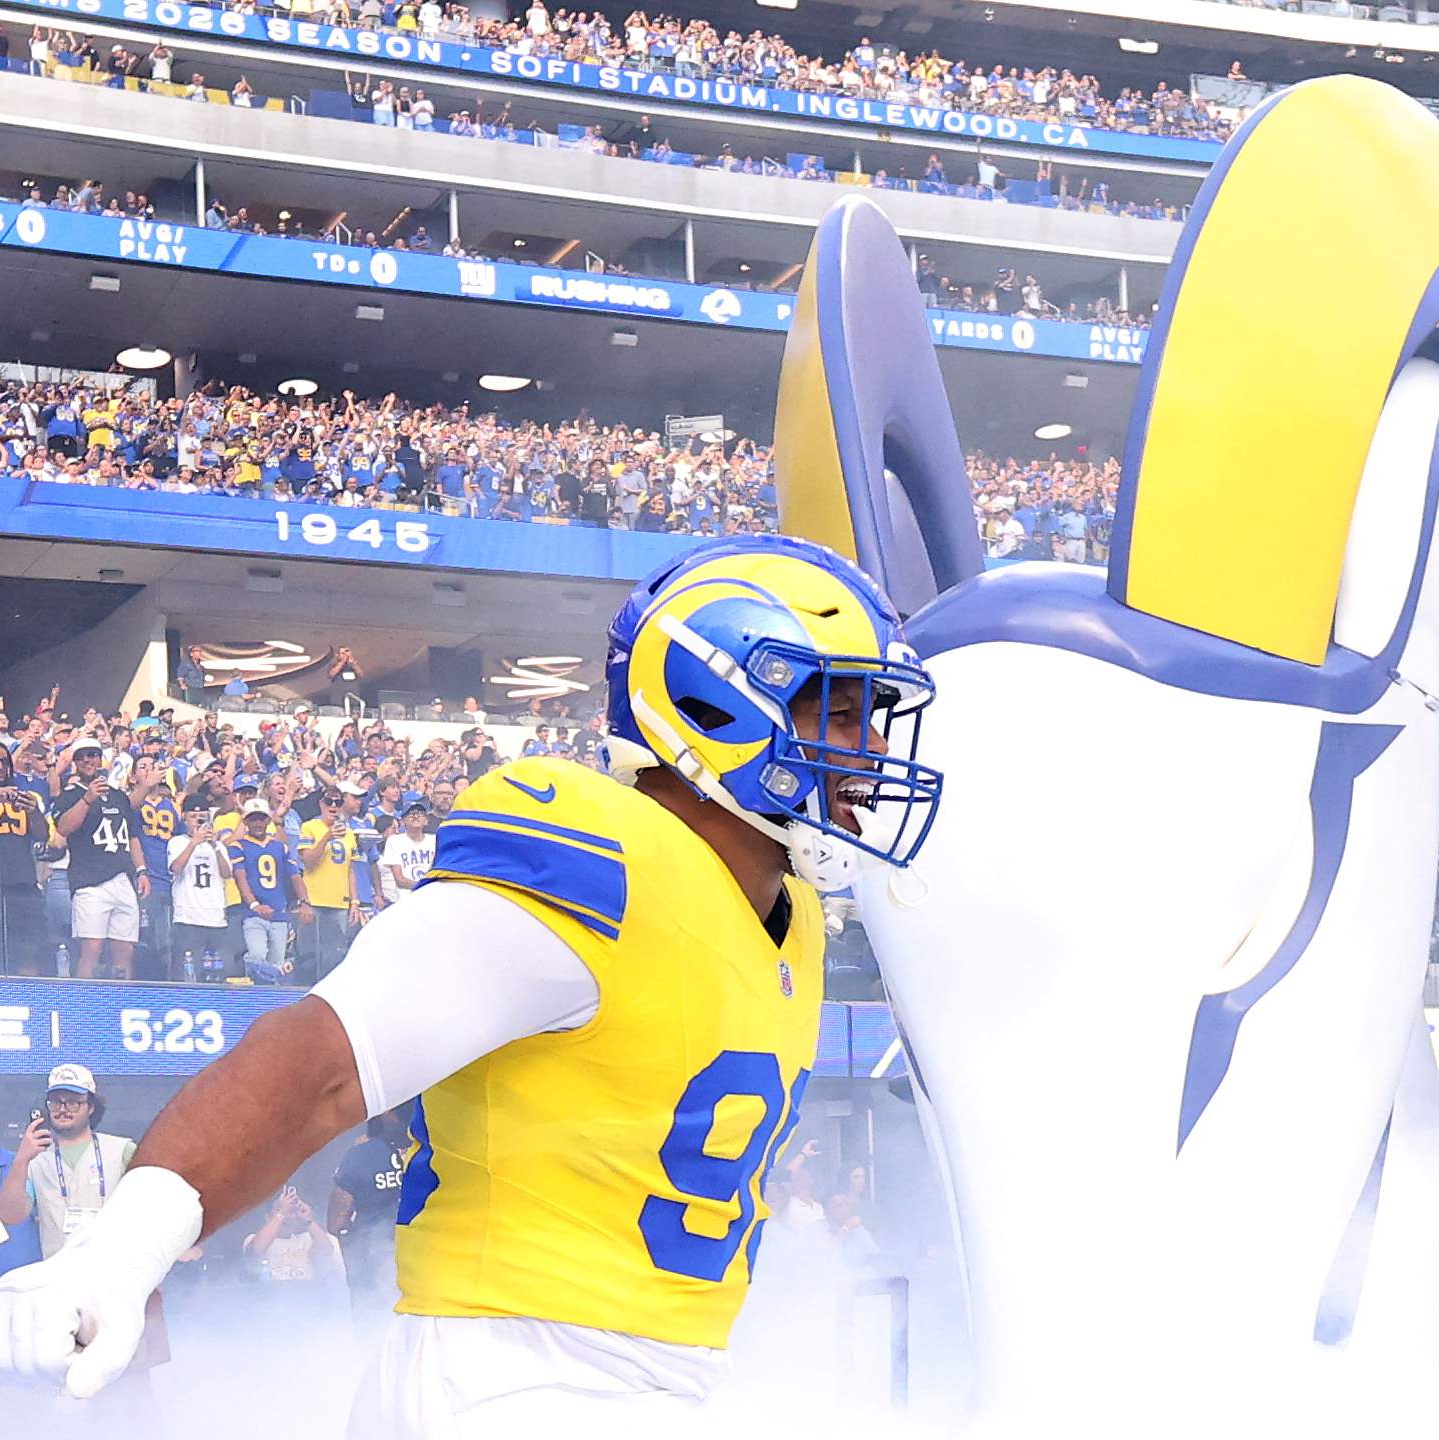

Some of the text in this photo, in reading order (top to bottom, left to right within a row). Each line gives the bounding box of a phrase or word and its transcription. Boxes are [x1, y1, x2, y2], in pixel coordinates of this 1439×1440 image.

[266, 22, 442, 64] SEASON
[491, 51, 581, 81] SOFI
[795, 92, 1027, 143] INGLEWOOD,
[1043, 127, 1089, 148] CA
[16, 209, 46, 244] 0
[119, 219, 184, 243] AVG/
[119, 240, 187, 264] PLAY
[370, 253, 397, 285] 0
[531, 275, 672, 311] RUSHING
[933, 317, 1035, 350] YARDS 0
[1090, 343, 1143, 363] PLAY
[695, 497, 706, 512] 9
[275, 511, 430, 552] 1945
[92, 819, 130, 853] 44
[141, 808, 174, 838] 99
[330, 839, 346, 864] 9
[401, 851, 434, 868] RAM
[193, 864, 211, 888] 6
[258, 854, 277, 888] 9
[120, 1009, 224, 1053] 5:23
[638, 1050, 810, 1282] 9
